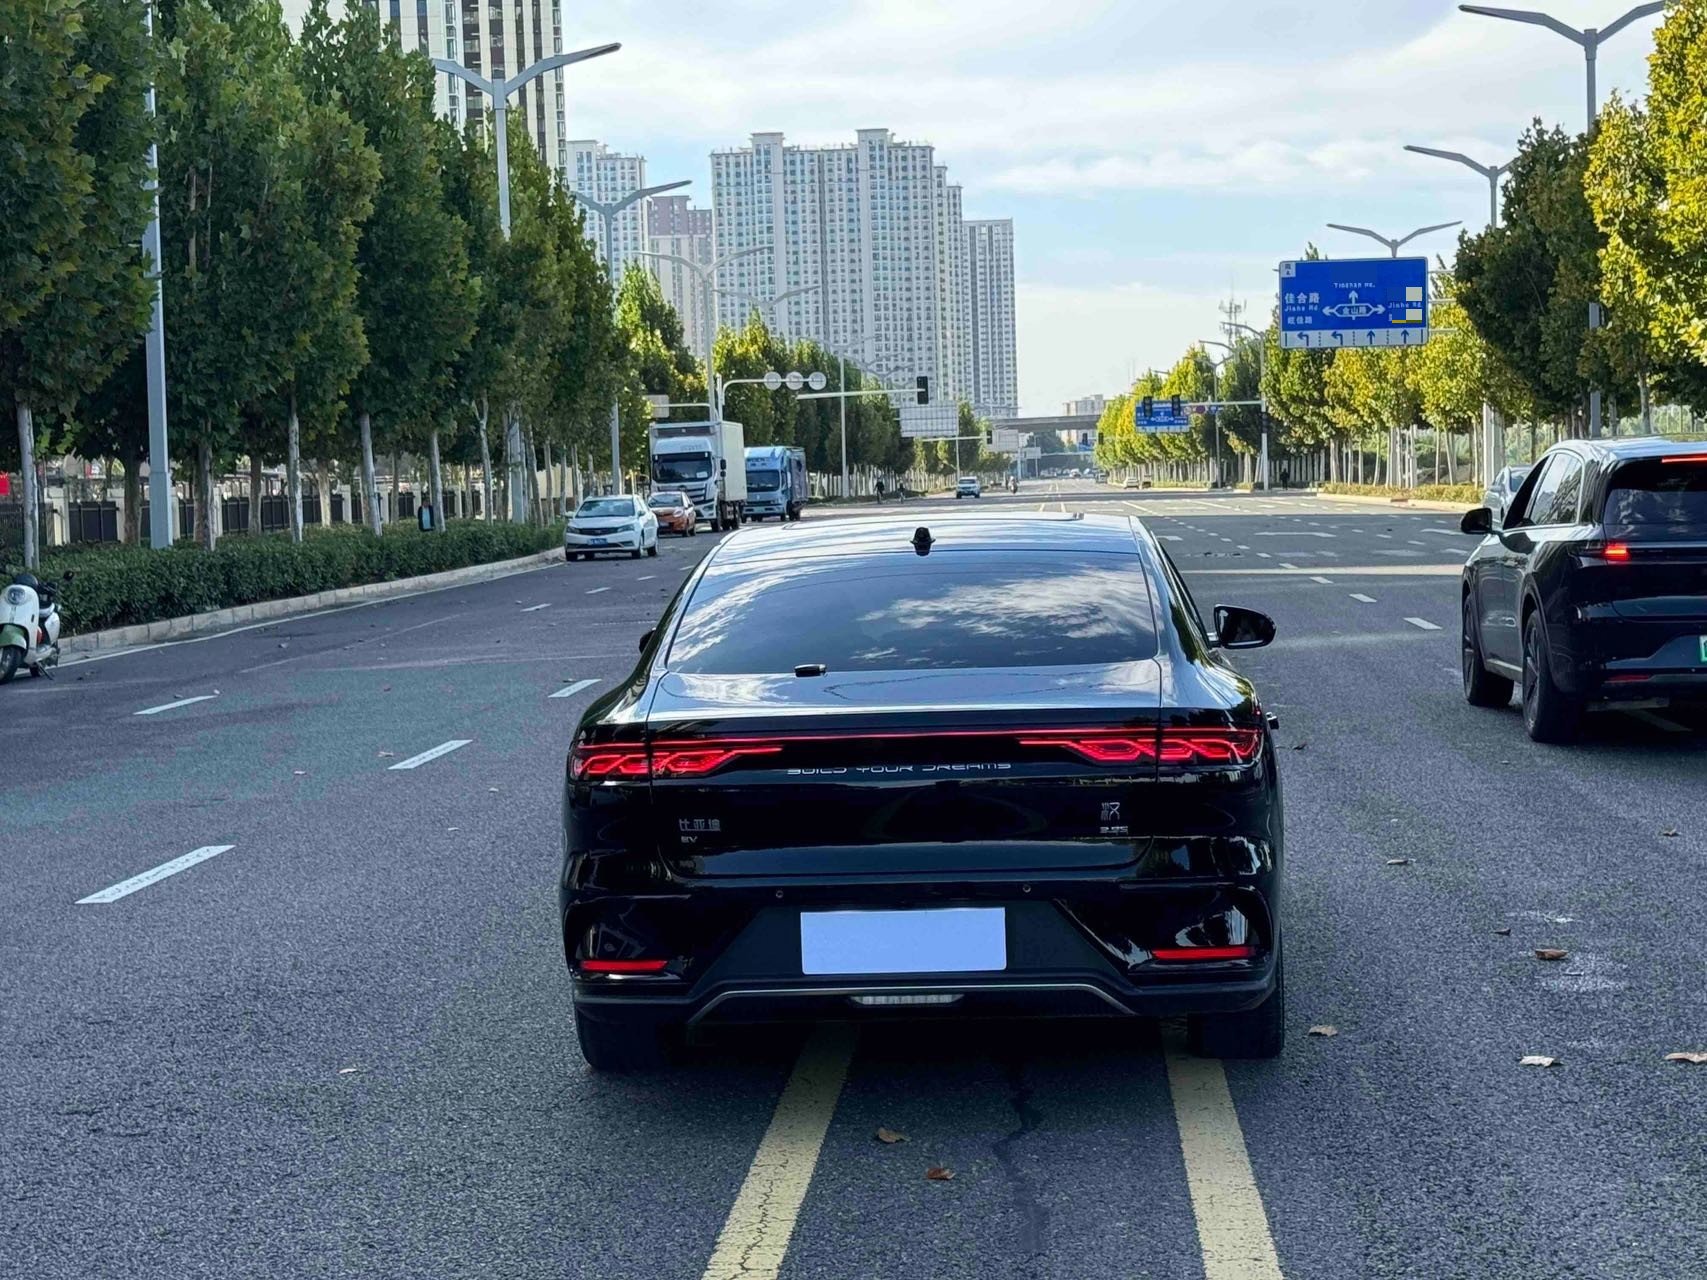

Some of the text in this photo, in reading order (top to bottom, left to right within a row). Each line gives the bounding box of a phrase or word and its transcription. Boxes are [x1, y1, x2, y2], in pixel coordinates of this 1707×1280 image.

[856, 764, 914, 773] YOUR
[921, 762, 1012, 772] DREAMS
[678, 818, 721, 832] 比亚迪
[680, 835, 698, 844] EV
